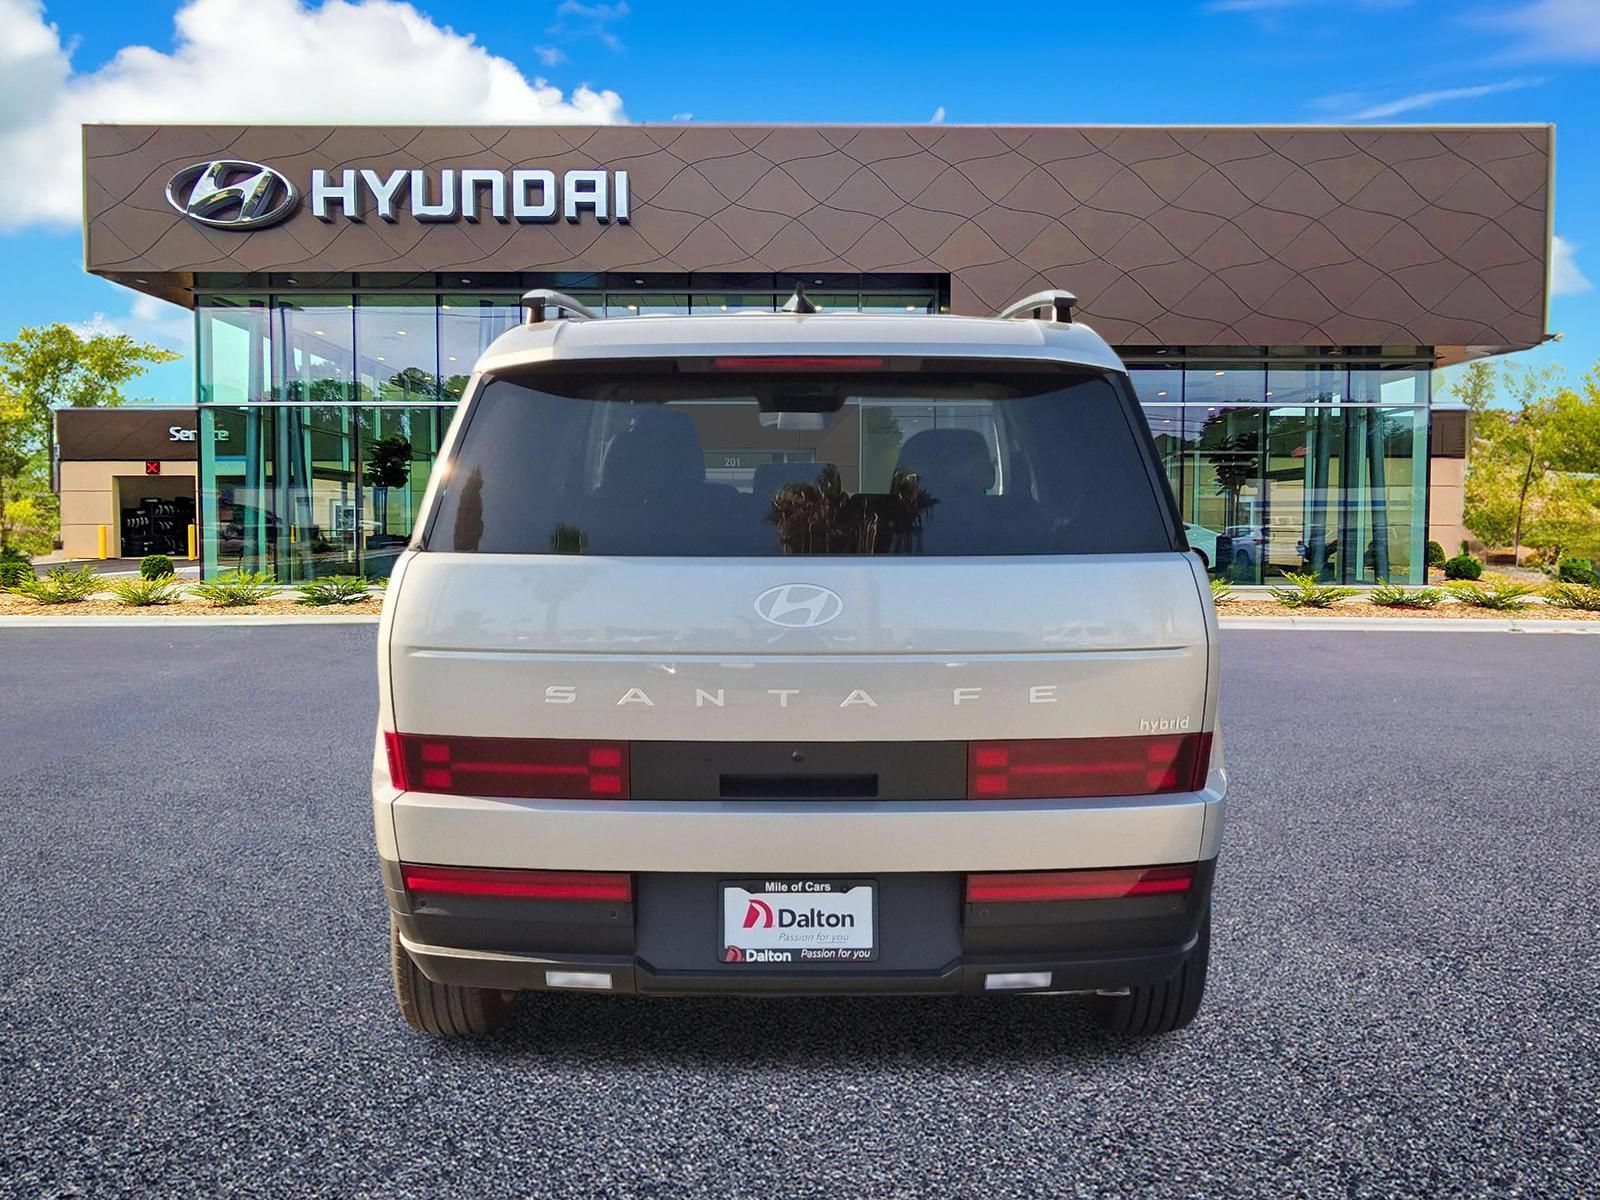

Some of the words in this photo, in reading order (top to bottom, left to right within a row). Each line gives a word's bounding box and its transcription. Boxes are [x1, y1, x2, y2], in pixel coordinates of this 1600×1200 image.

[311, 168, 631, 224] HYUNDAI
[724, 457, 741, 467] 201
[544, 685, 878, 708] SANTA
[952, 685, 1058, 707] FE
[1138, 716, 1190, 733] hybrid
[765, 881, 788, 892] Mile
[791, 882, 803, 892] of
[805, 881, 831, 892] Cars
[778, 908, 855, 928] Dalton
[778, 932, 815, 943] Passion
[817, 932, 831, 943] for
[831, 934, 849, 943] you
[746, 949, 791, 962] Dalton
[800, 949, 836, 960] Passion
[837, 948, 852, 959] for
[852, 950, 871, 960] you
